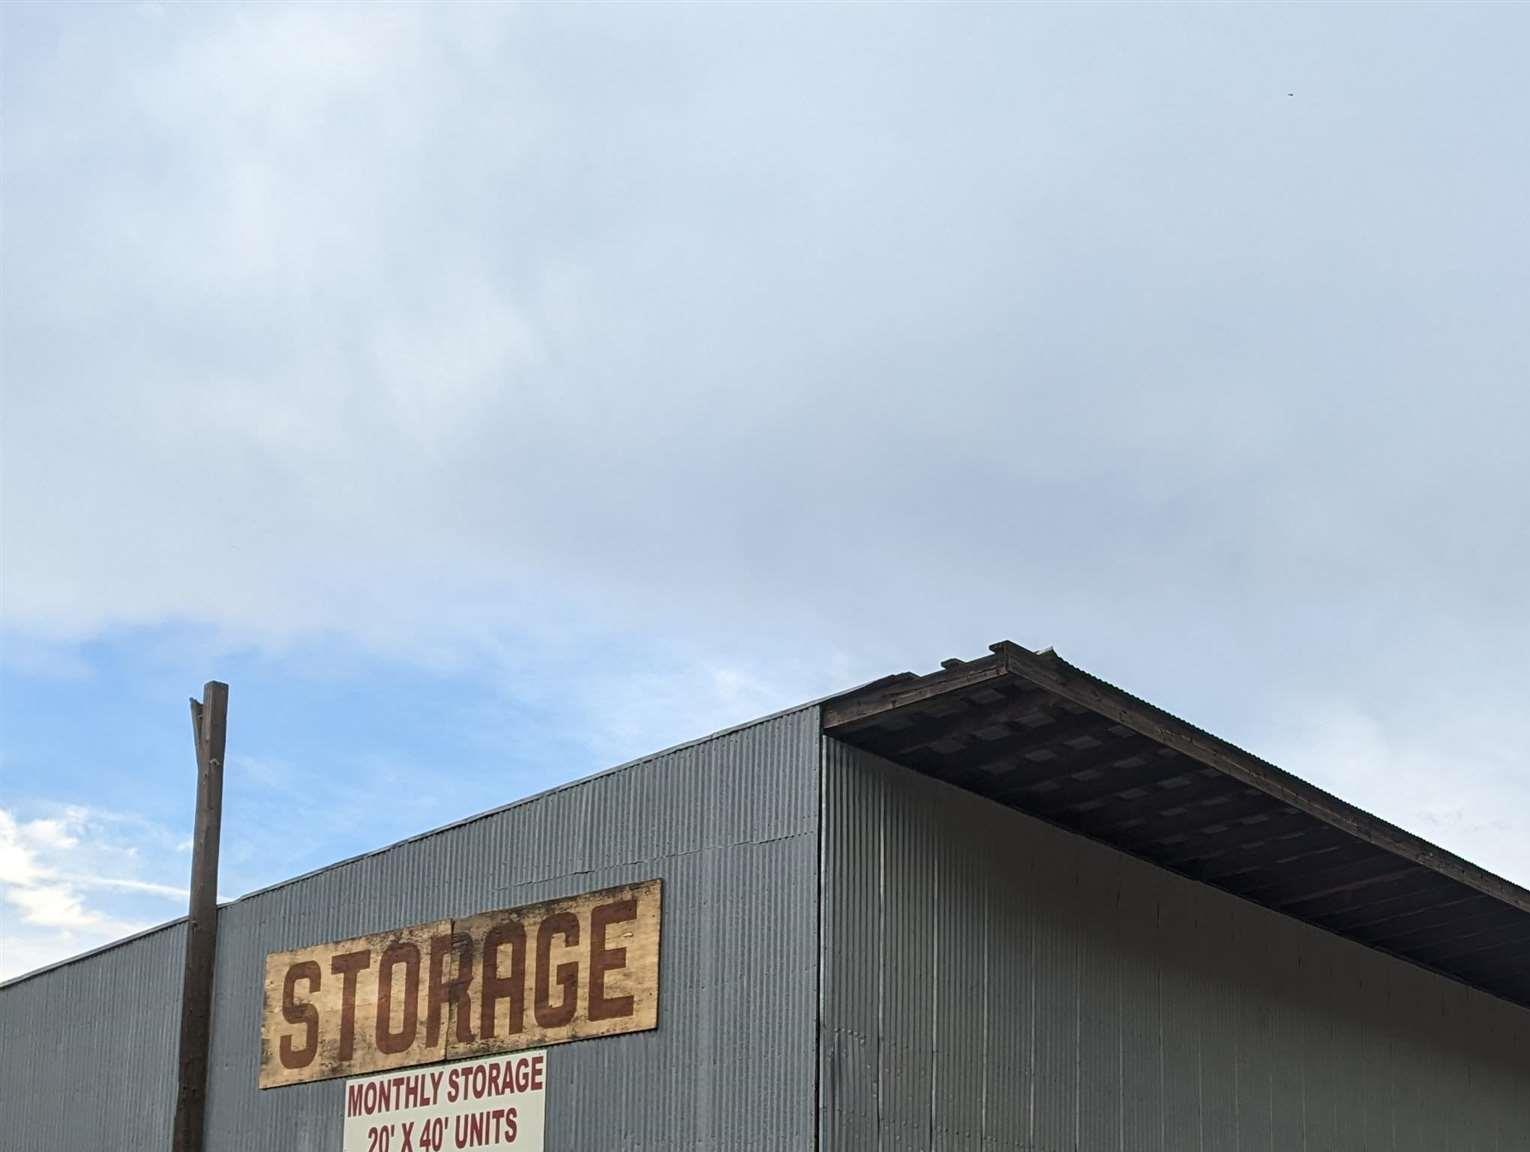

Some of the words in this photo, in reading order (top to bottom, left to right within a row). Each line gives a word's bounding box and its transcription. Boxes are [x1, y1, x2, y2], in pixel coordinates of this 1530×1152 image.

[279, 899, 638, 1070] STORAGE
[347, 1070, 444, 1118] MONTHLY
[447, 1055, 544, 1103] STORAGE
[419, 1116, 449, 1152] 40'
[454, 1107, 518, 1149] UNITS
